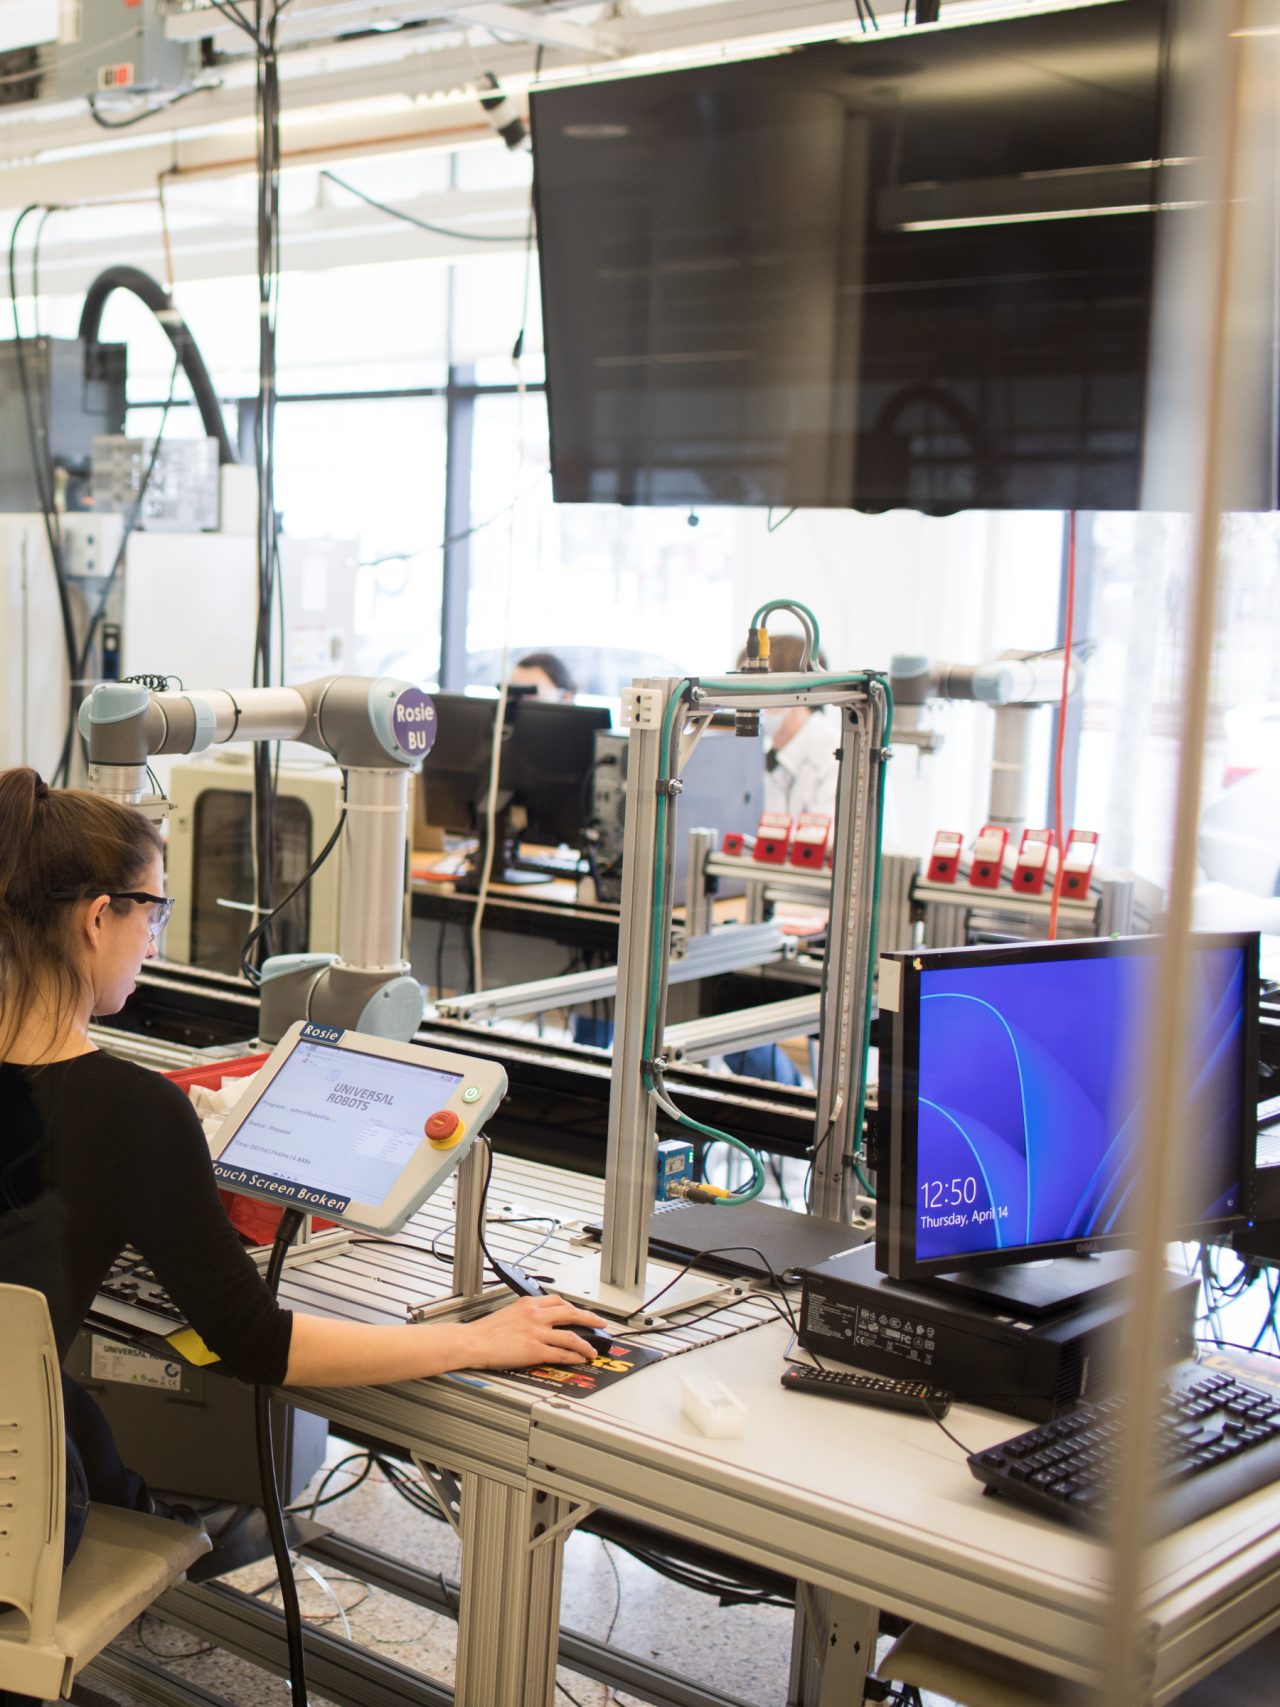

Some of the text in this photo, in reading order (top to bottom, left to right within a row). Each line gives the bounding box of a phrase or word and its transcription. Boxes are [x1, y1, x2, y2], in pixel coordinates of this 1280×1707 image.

[396, 702, 435, 723] Rosie
[407, 730, 427, 750] BU
[303, 1024, 339, 1042] Rosie
[326, 1092, 372, 1112] ROBOTS
[333, 1082, 395, 1106] UNIVERSAL
[248, 1174, 296, 1196] Screen
[297, 1188, 346, 1211] Broken
[920, 1176, 977, 1209] 12:50
[920, 1206, 1009, 1229] Thursday, April 14
